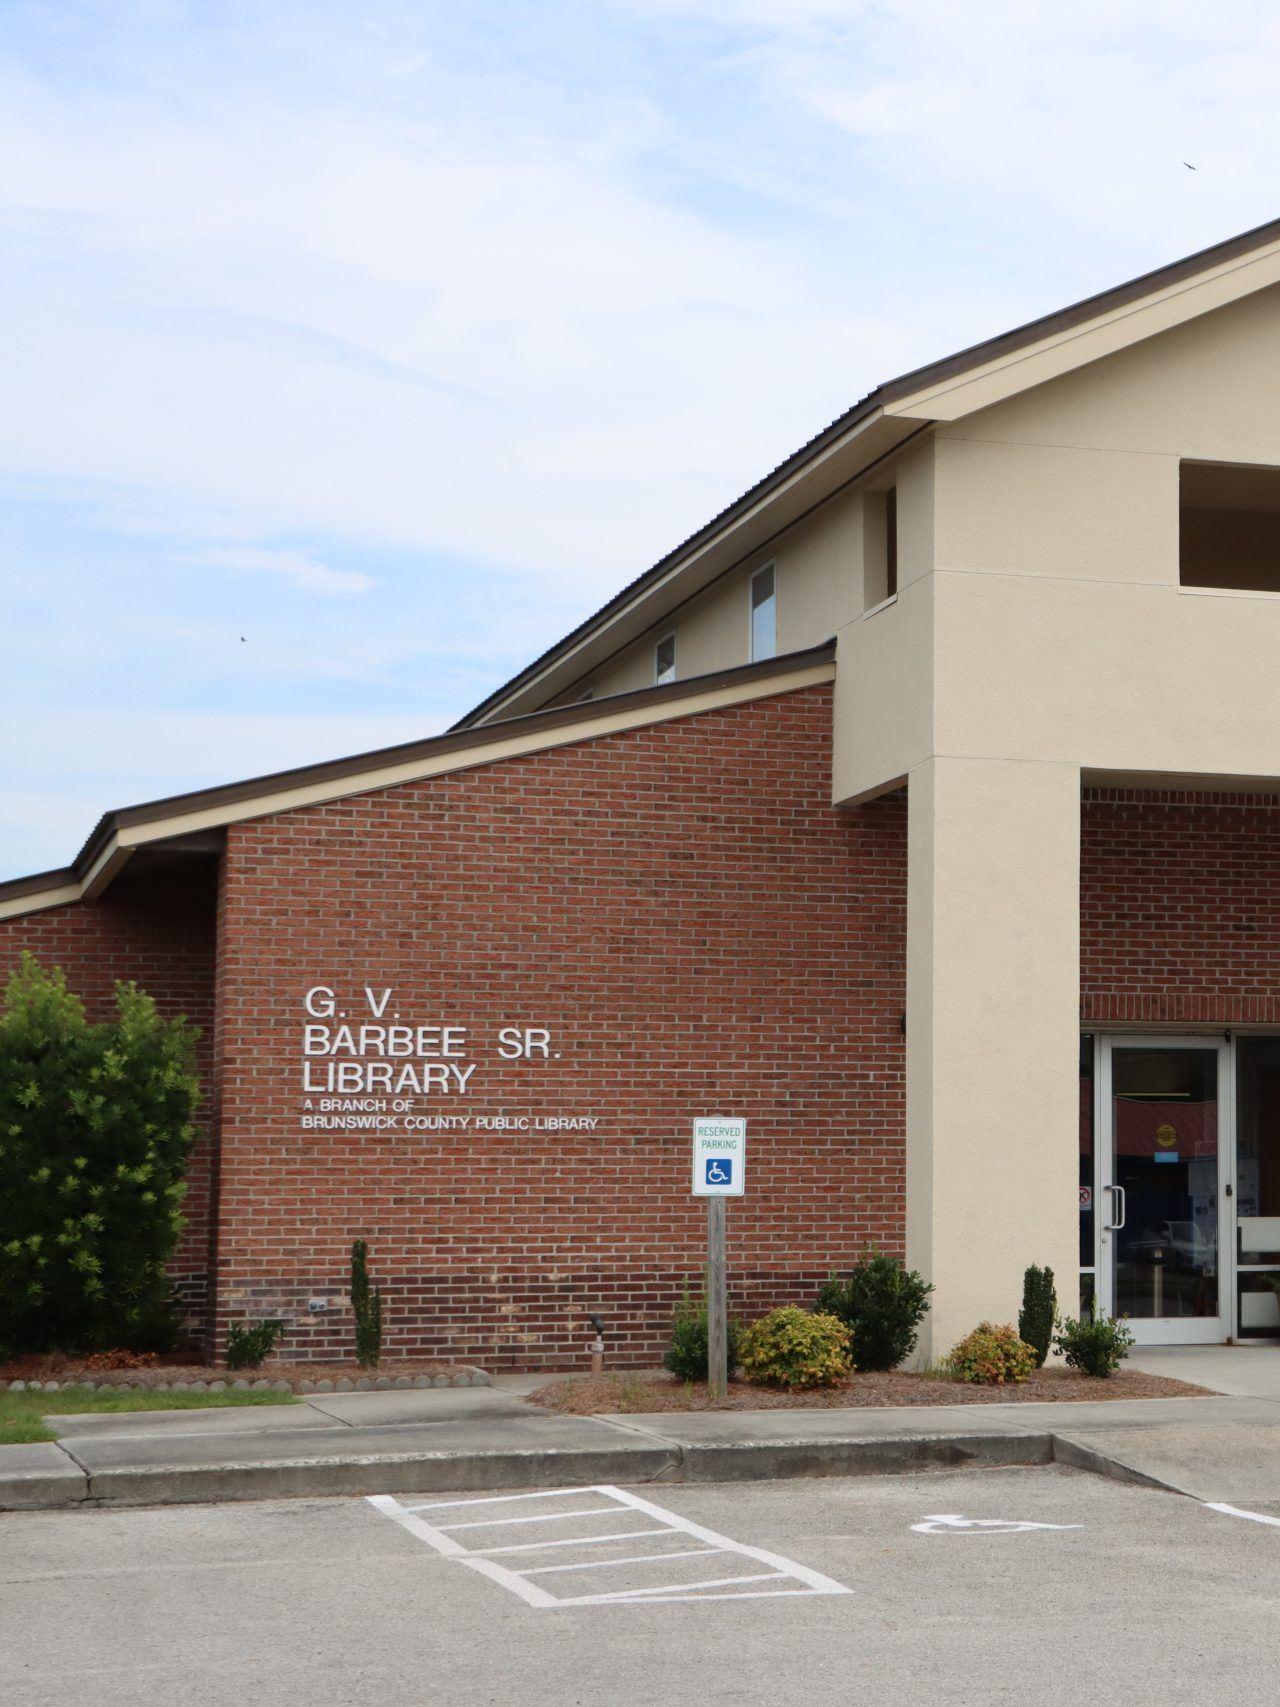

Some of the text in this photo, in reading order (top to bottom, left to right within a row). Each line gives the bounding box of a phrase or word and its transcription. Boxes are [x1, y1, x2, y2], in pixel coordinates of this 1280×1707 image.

[305, 986, 400, 1019] G. V.
[304, 1025, 561, 1059] BARBEE SR.
[304, 1061, 477, 1094] LIBRARY
[303, 1099, 414, 1112] A BRANCH OF
[302, 1116, 599, 1130] BRUNSWICK COUNTY PUBLIC LIBRARY
[698, 1126, 741, 1137] RESERVED
[701, 1139, 737, 1149] PARKING
